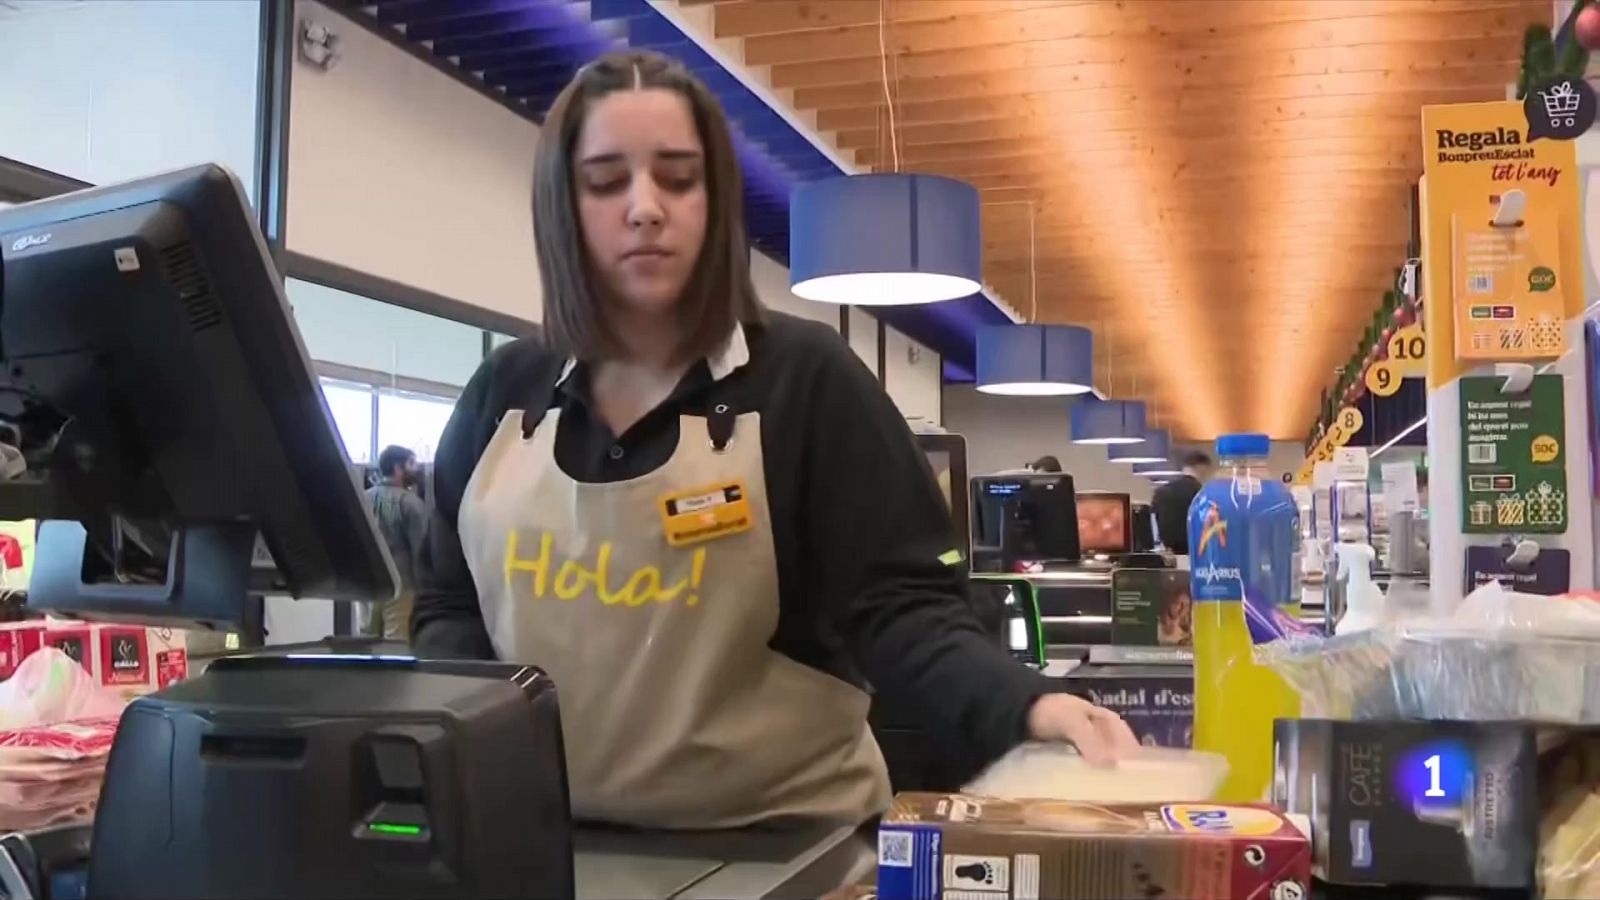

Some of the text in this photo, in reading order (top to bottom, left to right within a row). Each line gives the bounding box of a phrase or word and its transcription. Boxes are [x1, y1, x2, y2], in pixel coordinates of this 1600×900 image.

[1437, 127, 1521, 151] Regala
[1491, 163, 1514, 181] tot
[1394, 337, 1426, 360] 10
[1376, 368, 1390, 389] 9
[1344, 411, 1355, 429] 8
[1335, 426, 1342, 440] 7
[504, 528, 706, 607] Hola!
[1154, 688, 1193, 706] d'es
